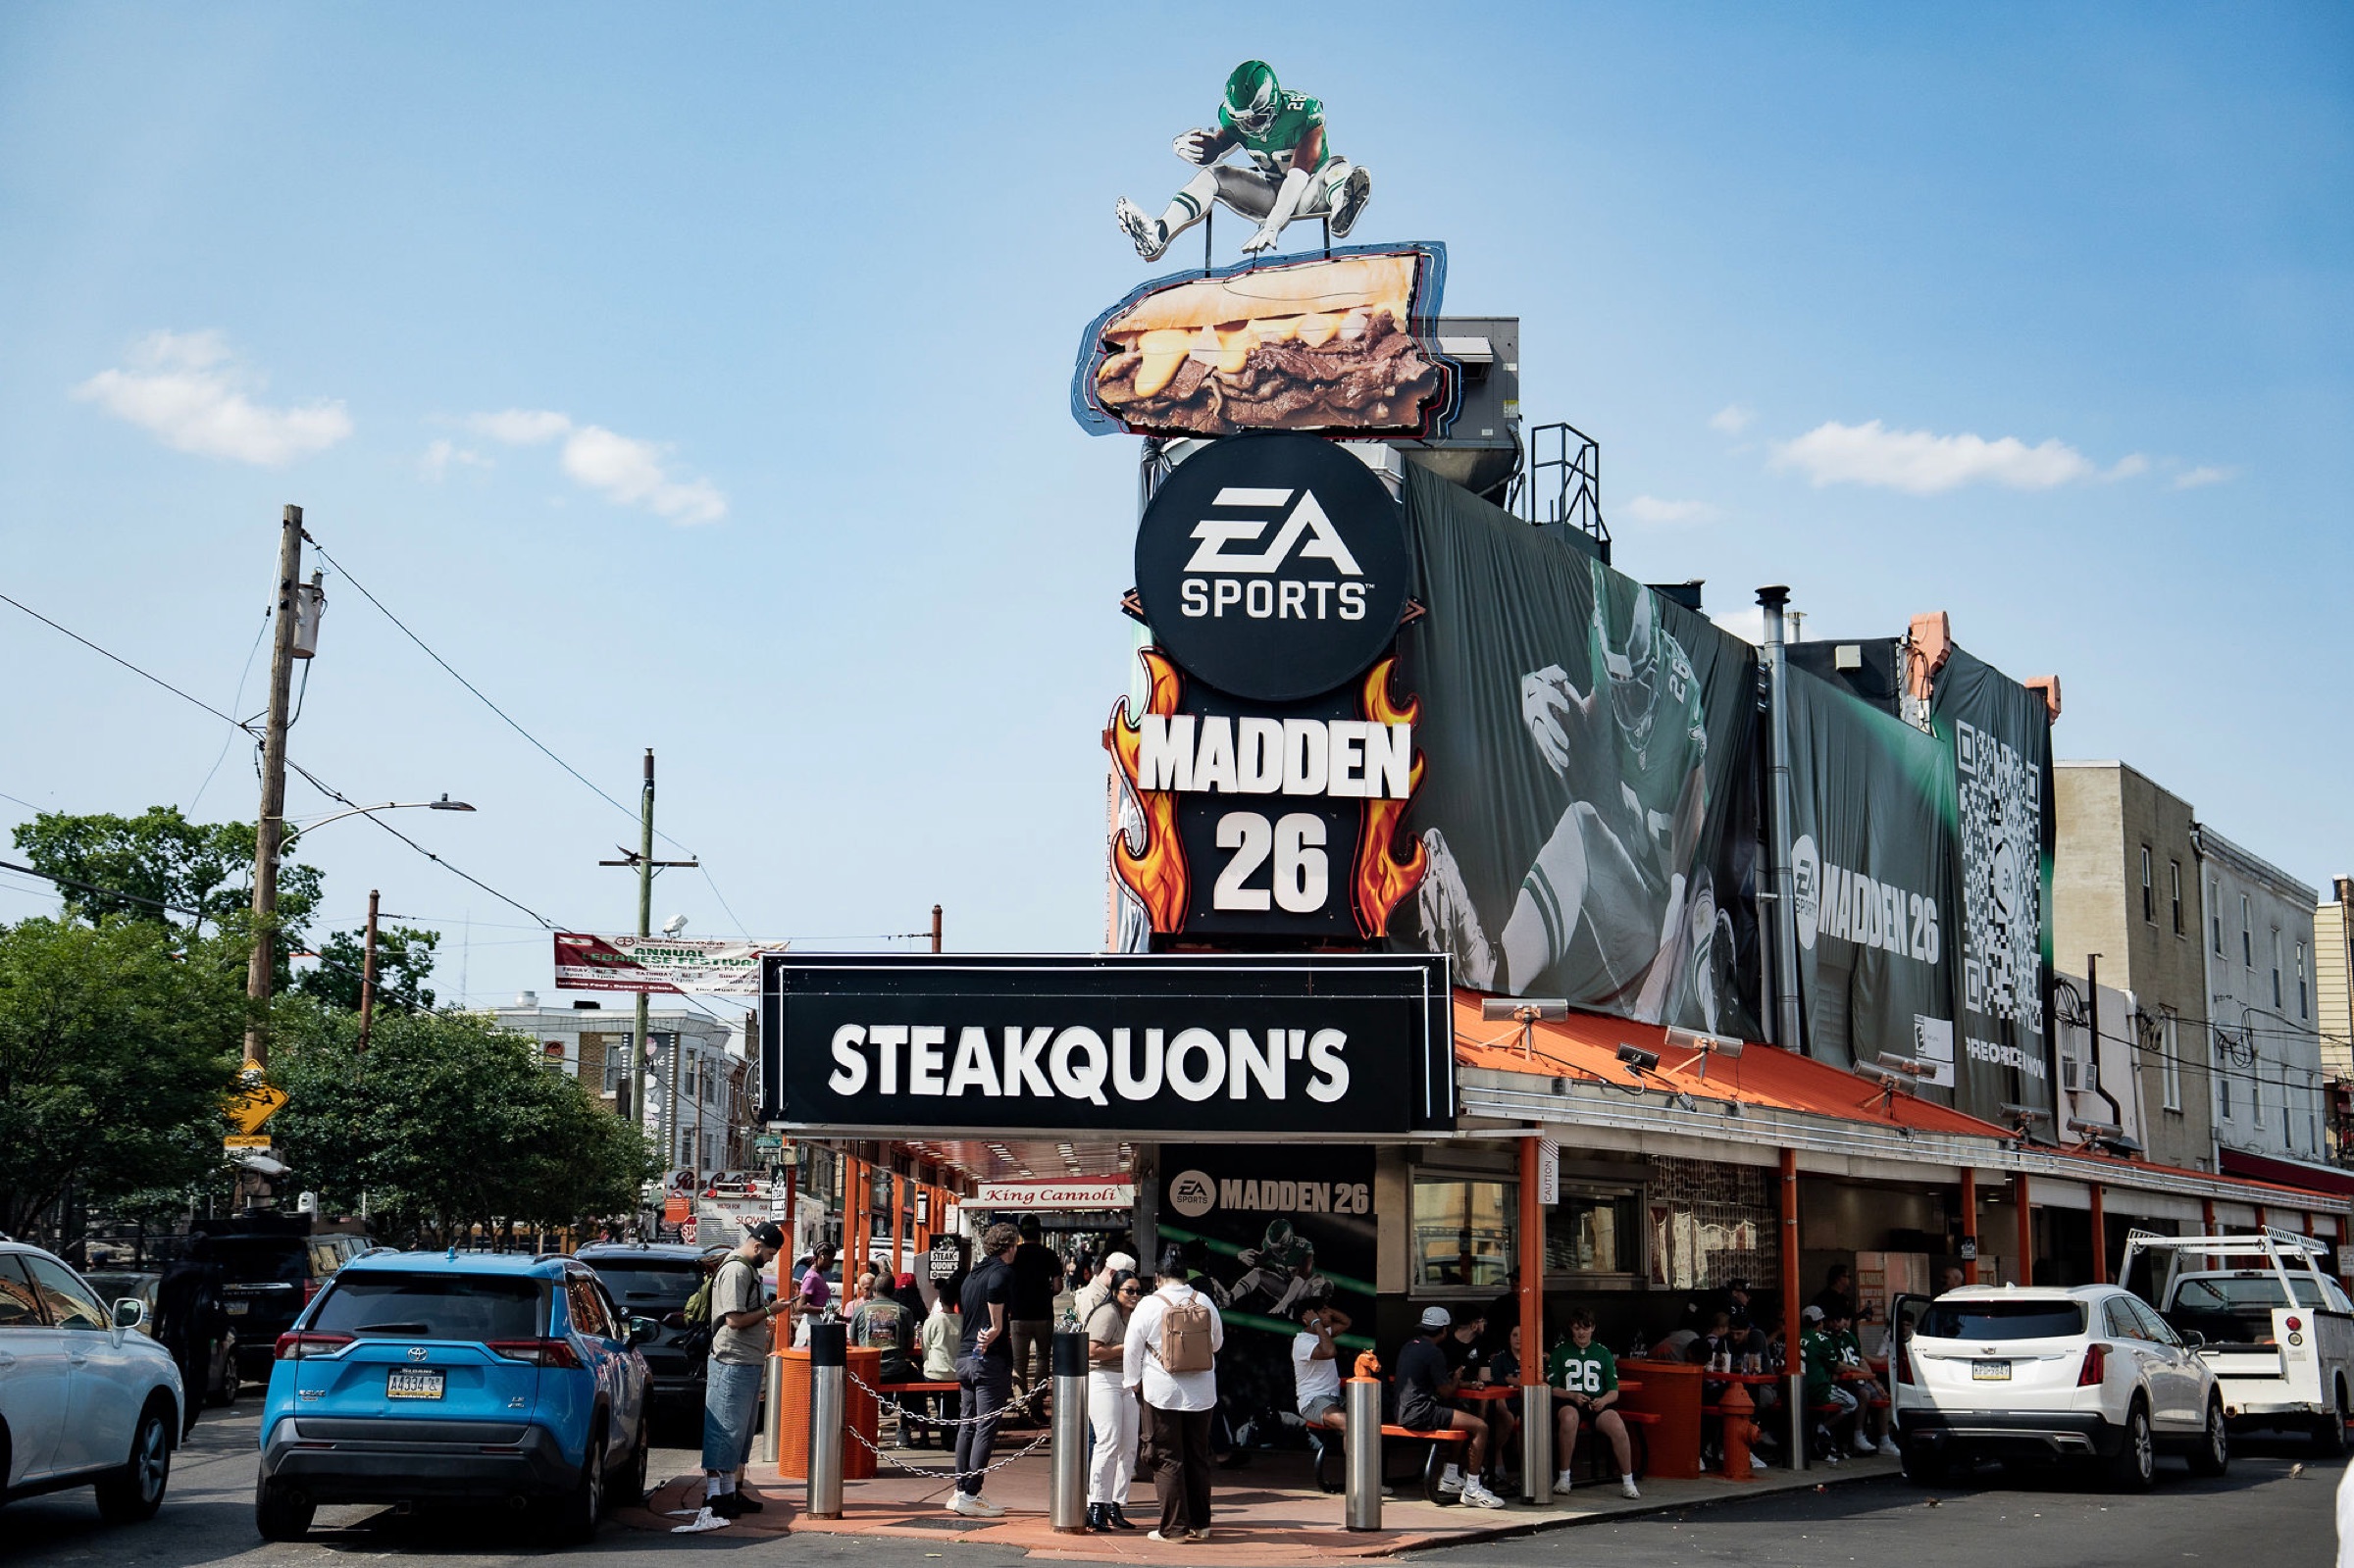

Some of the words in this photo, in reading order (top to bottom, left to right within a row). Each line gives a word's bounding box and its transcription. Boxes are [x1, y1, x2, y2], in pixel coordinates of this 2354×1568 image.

[1183, 487, 1364, 576] EA
[1182, 579, 1366, 621] SPORTS
[1137, 713, 1411, 799] MADDEN
[1213, 810, 1329, 913] 26
[1818, 861, 1909, 956] MADDEN
[1910, 892, 1939, 965] 26
[582, 952, 673, 964] LEBANESE
[634, 947, 706, 957] ANNUAL
[828, 1023, 1350, 1106] STEAKQUON'S
[984, 1189, 1036, 1204] King
[1040, 1188, 1116, 1201] Cannoli
[1177, 1195, 1208, 1204] SPORTS
[1178, 1180, 1207, 1196] EA
[1219, 1179, 1330, 1213] MADDEN
[1334, 1183, 1369, 1215] 26
[683, 1225, 696, 1237] ST
[930, 1261, 959, 1271] QUON'S
[390, 1376, 424, 1391] A4334
[1564, 1358, 1602, 1392] 26
